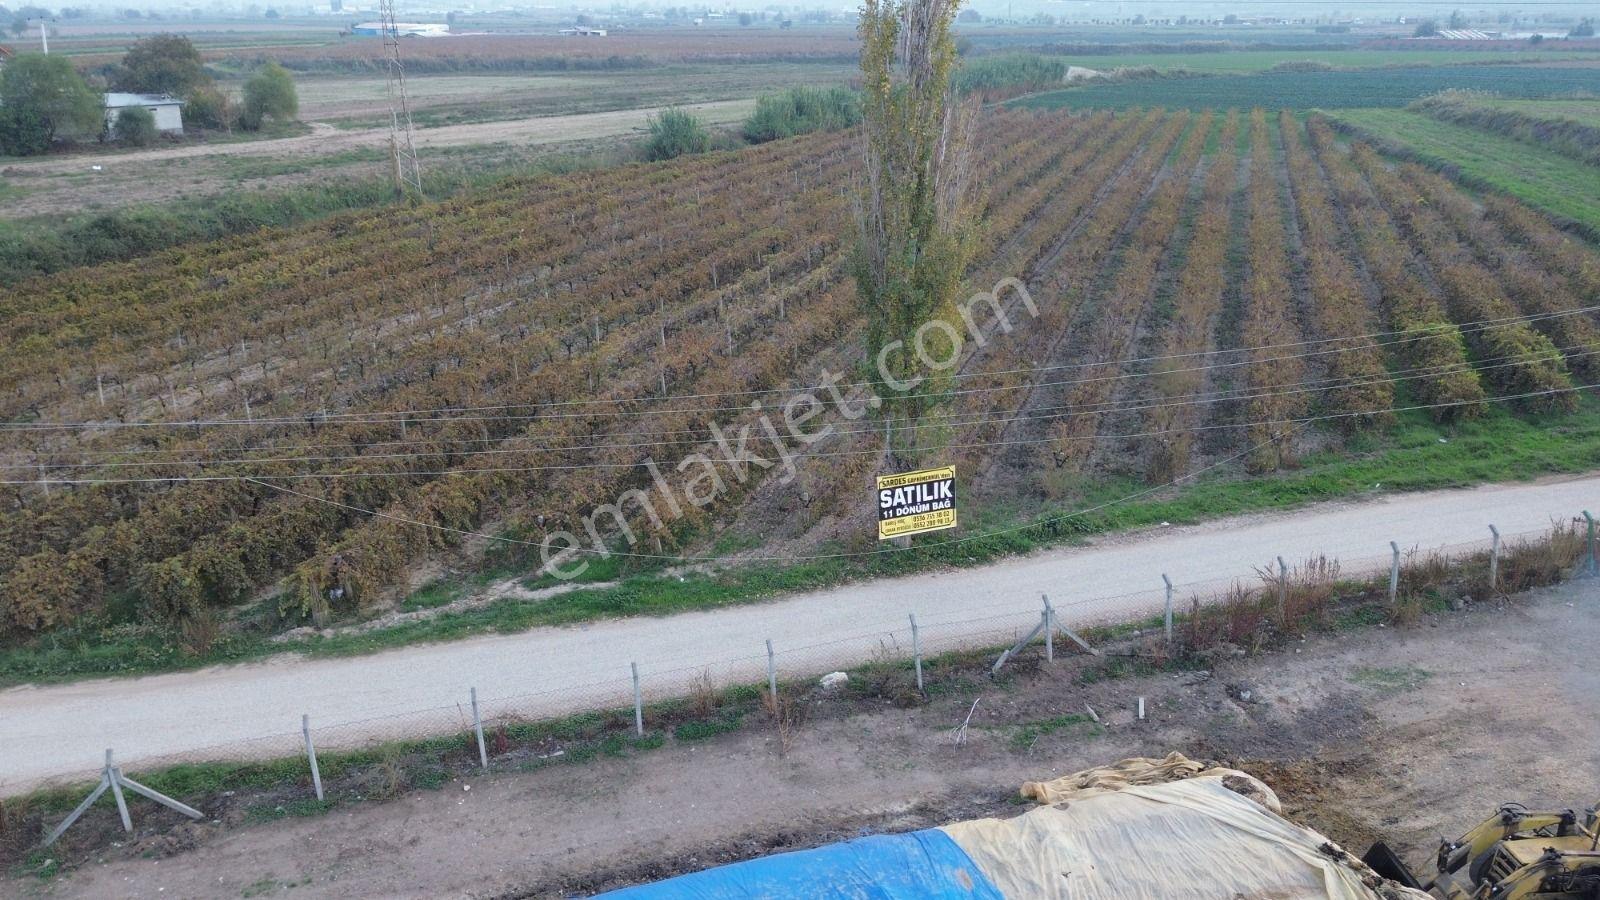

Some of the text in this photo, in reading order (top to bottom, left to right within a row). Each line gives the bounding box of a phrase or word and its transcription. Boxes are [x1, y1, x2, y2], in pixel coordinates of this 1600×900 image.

[882, 477, 906, 487] SARDES
[880, 480, 952, 508] SATILIK
[883, 498, 951, 519] 11 DÖNÜM BAĞ
